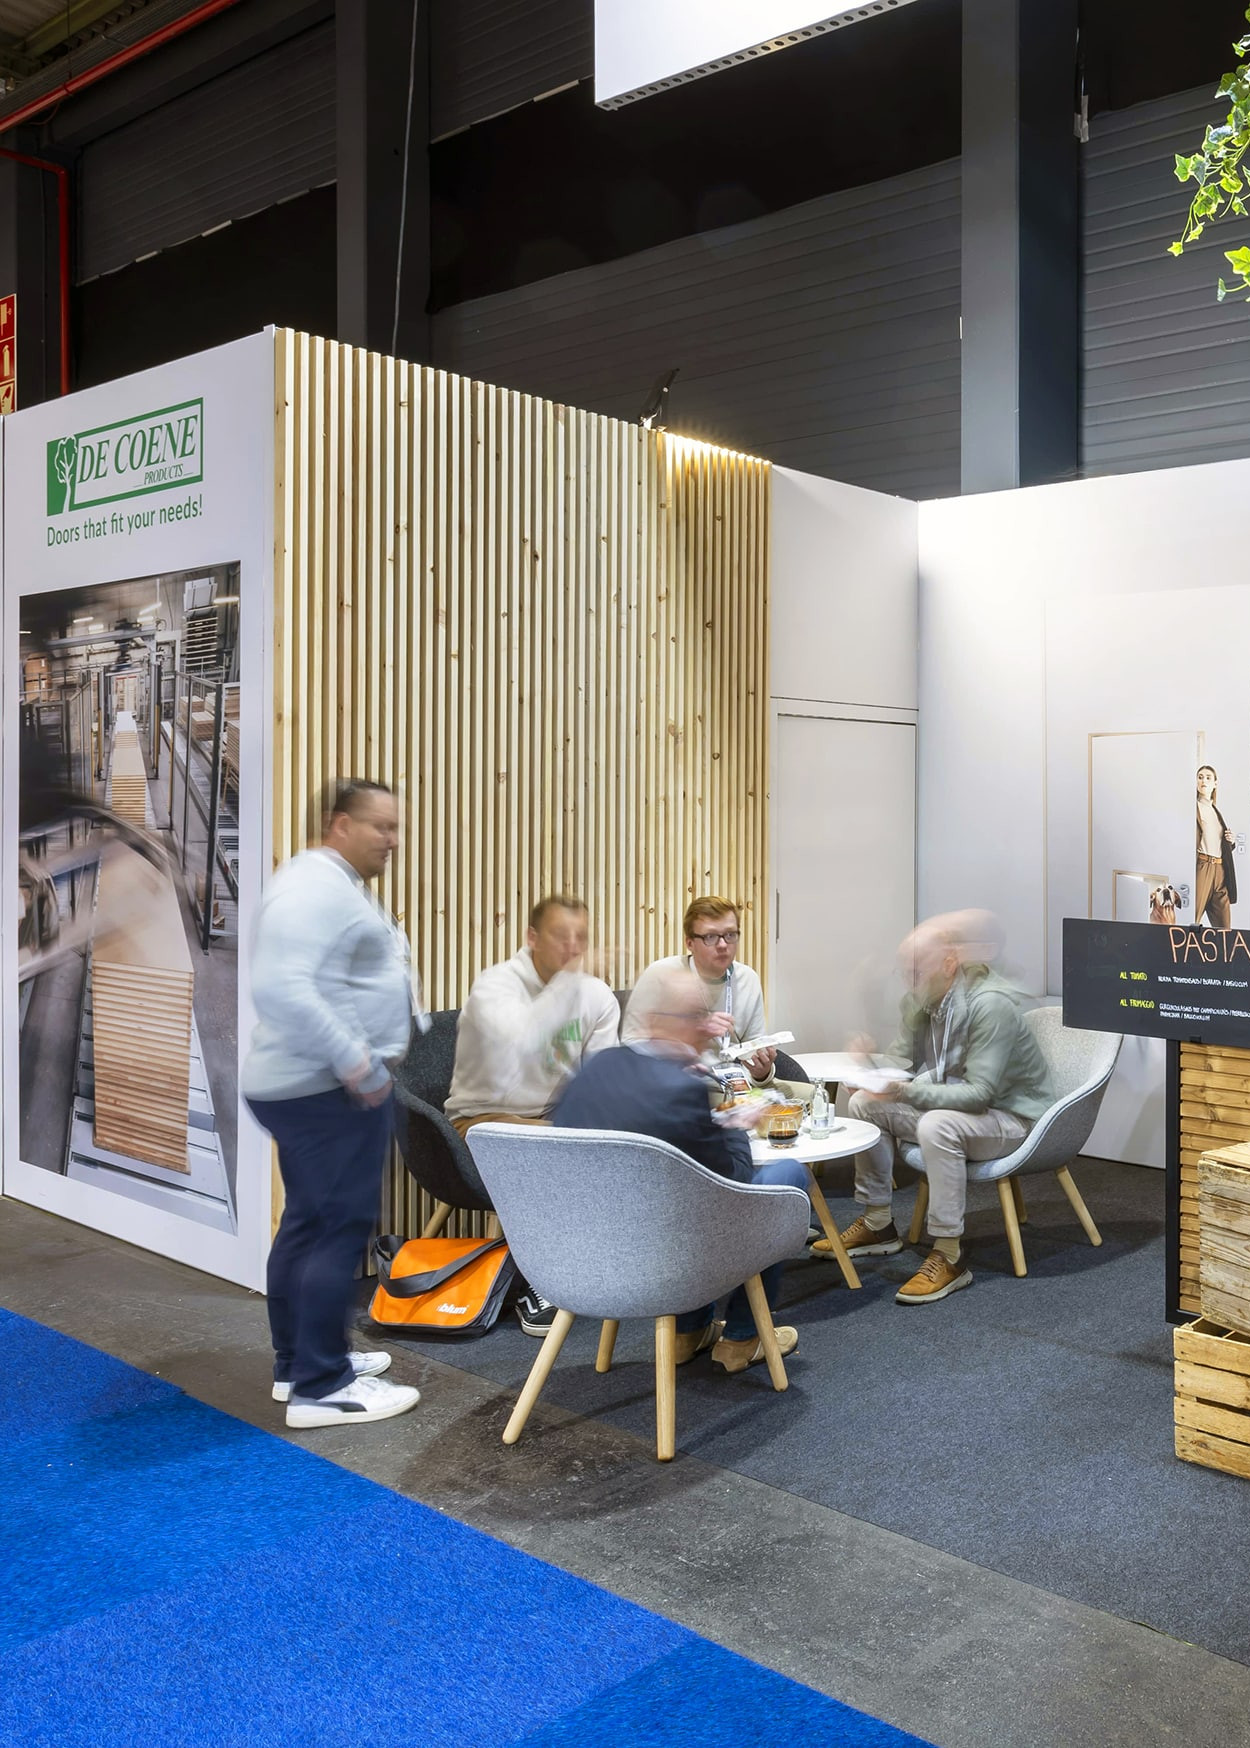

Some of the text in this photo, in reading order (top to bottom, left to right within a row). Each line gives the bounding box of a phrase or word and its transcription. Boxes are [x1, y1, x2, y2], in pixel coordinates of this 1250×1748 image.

[78, 414, 199, 483] DE COENE
[144, 463, 184, 485] PRODUCTS
[47, 494, 203, 547] Doors that fit your needs!
